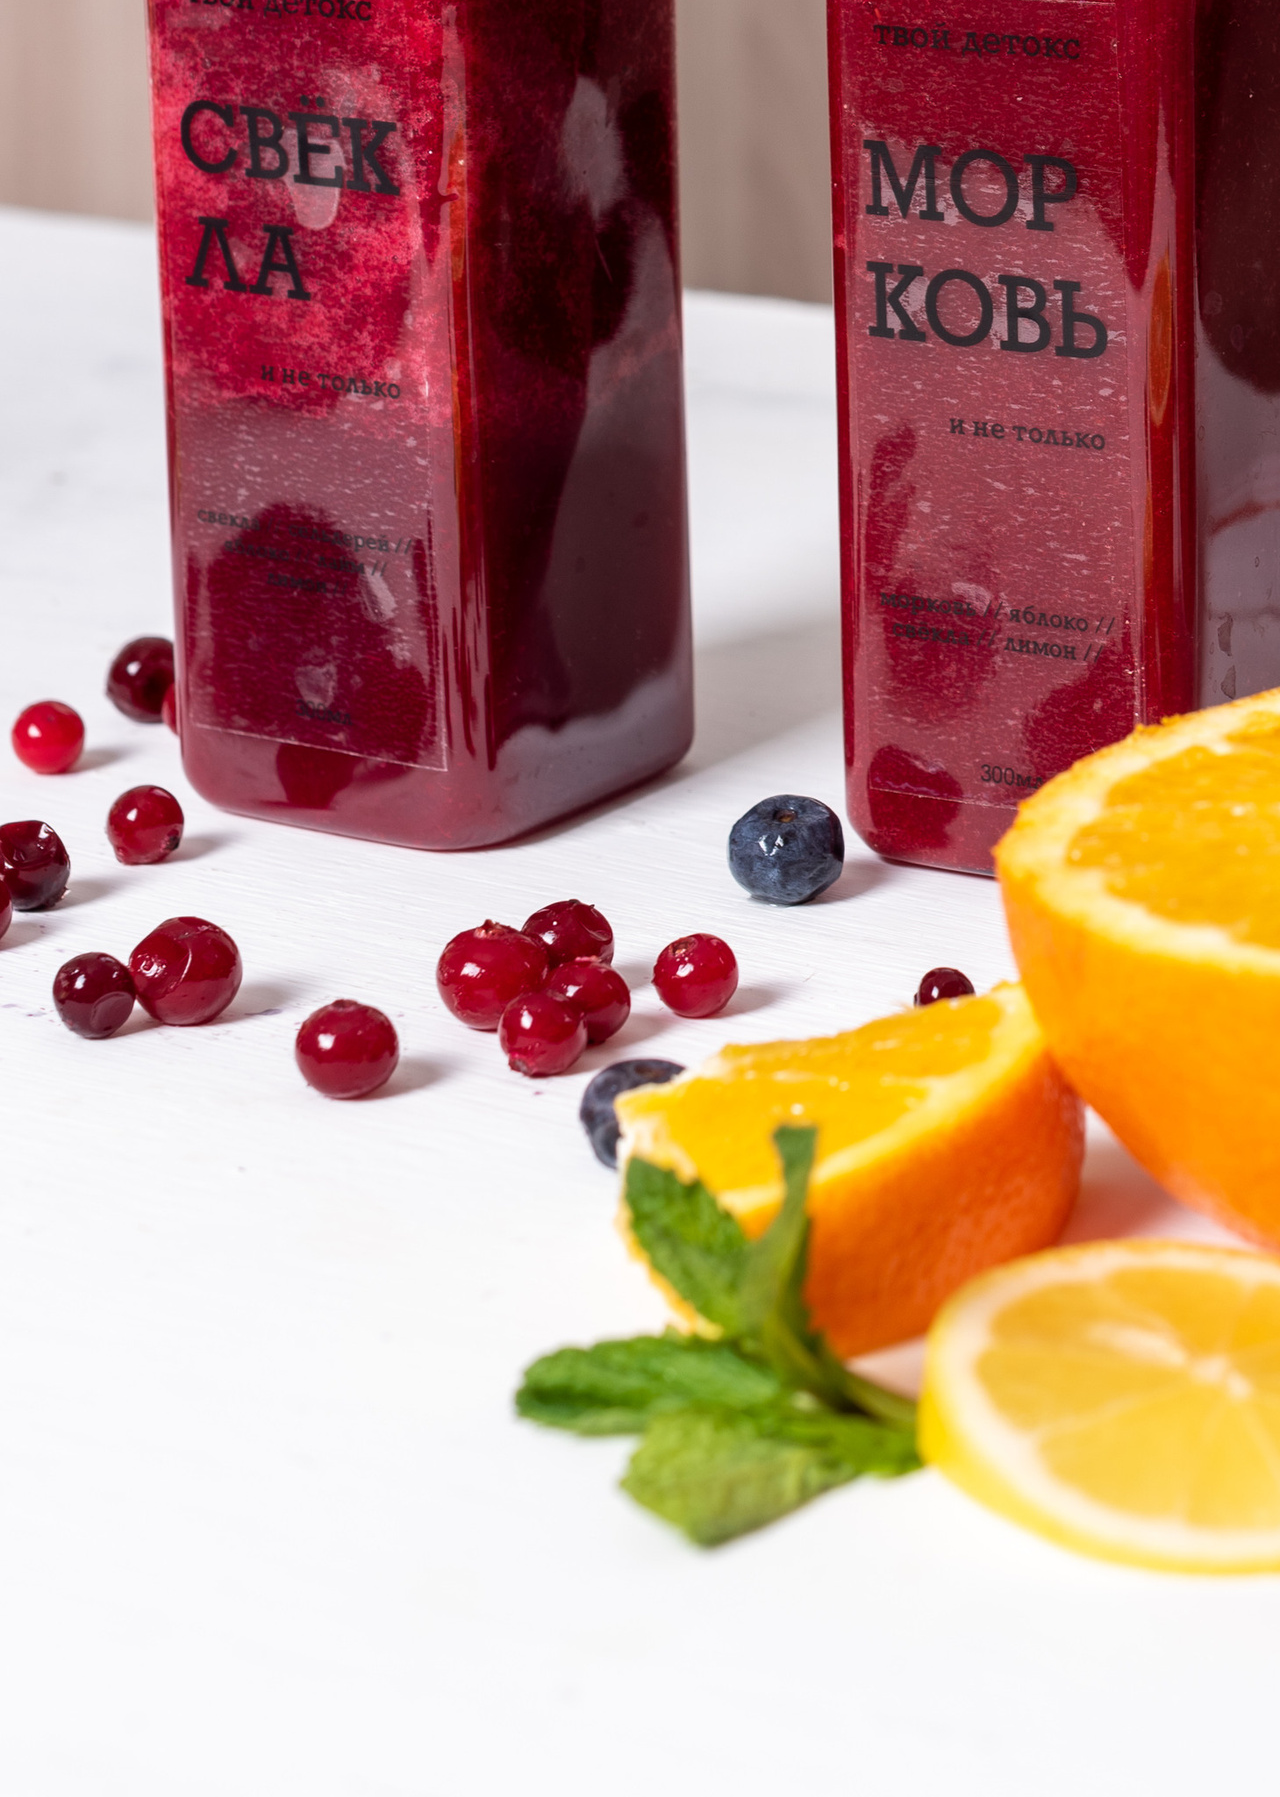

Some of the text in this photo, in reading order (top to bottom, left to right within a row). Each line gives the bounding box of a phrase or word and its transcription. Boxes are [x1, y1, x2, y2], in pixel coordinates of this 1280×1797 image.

[873, 23, 1080, 60] твой детокс
[181, 95, 400, 197] СВЁК
[863, 140, 1078, 232] МОР
[185, 216, 311, 302] ЛА
[866, 260, 1109, 359] КОВЬ
[261, 364, 401, 400] и не только
[949, 417, 1106, 452] и не только
[1009, 605, 1089, 633] яблоко
[1004, 637, 1077, 661] лимон
